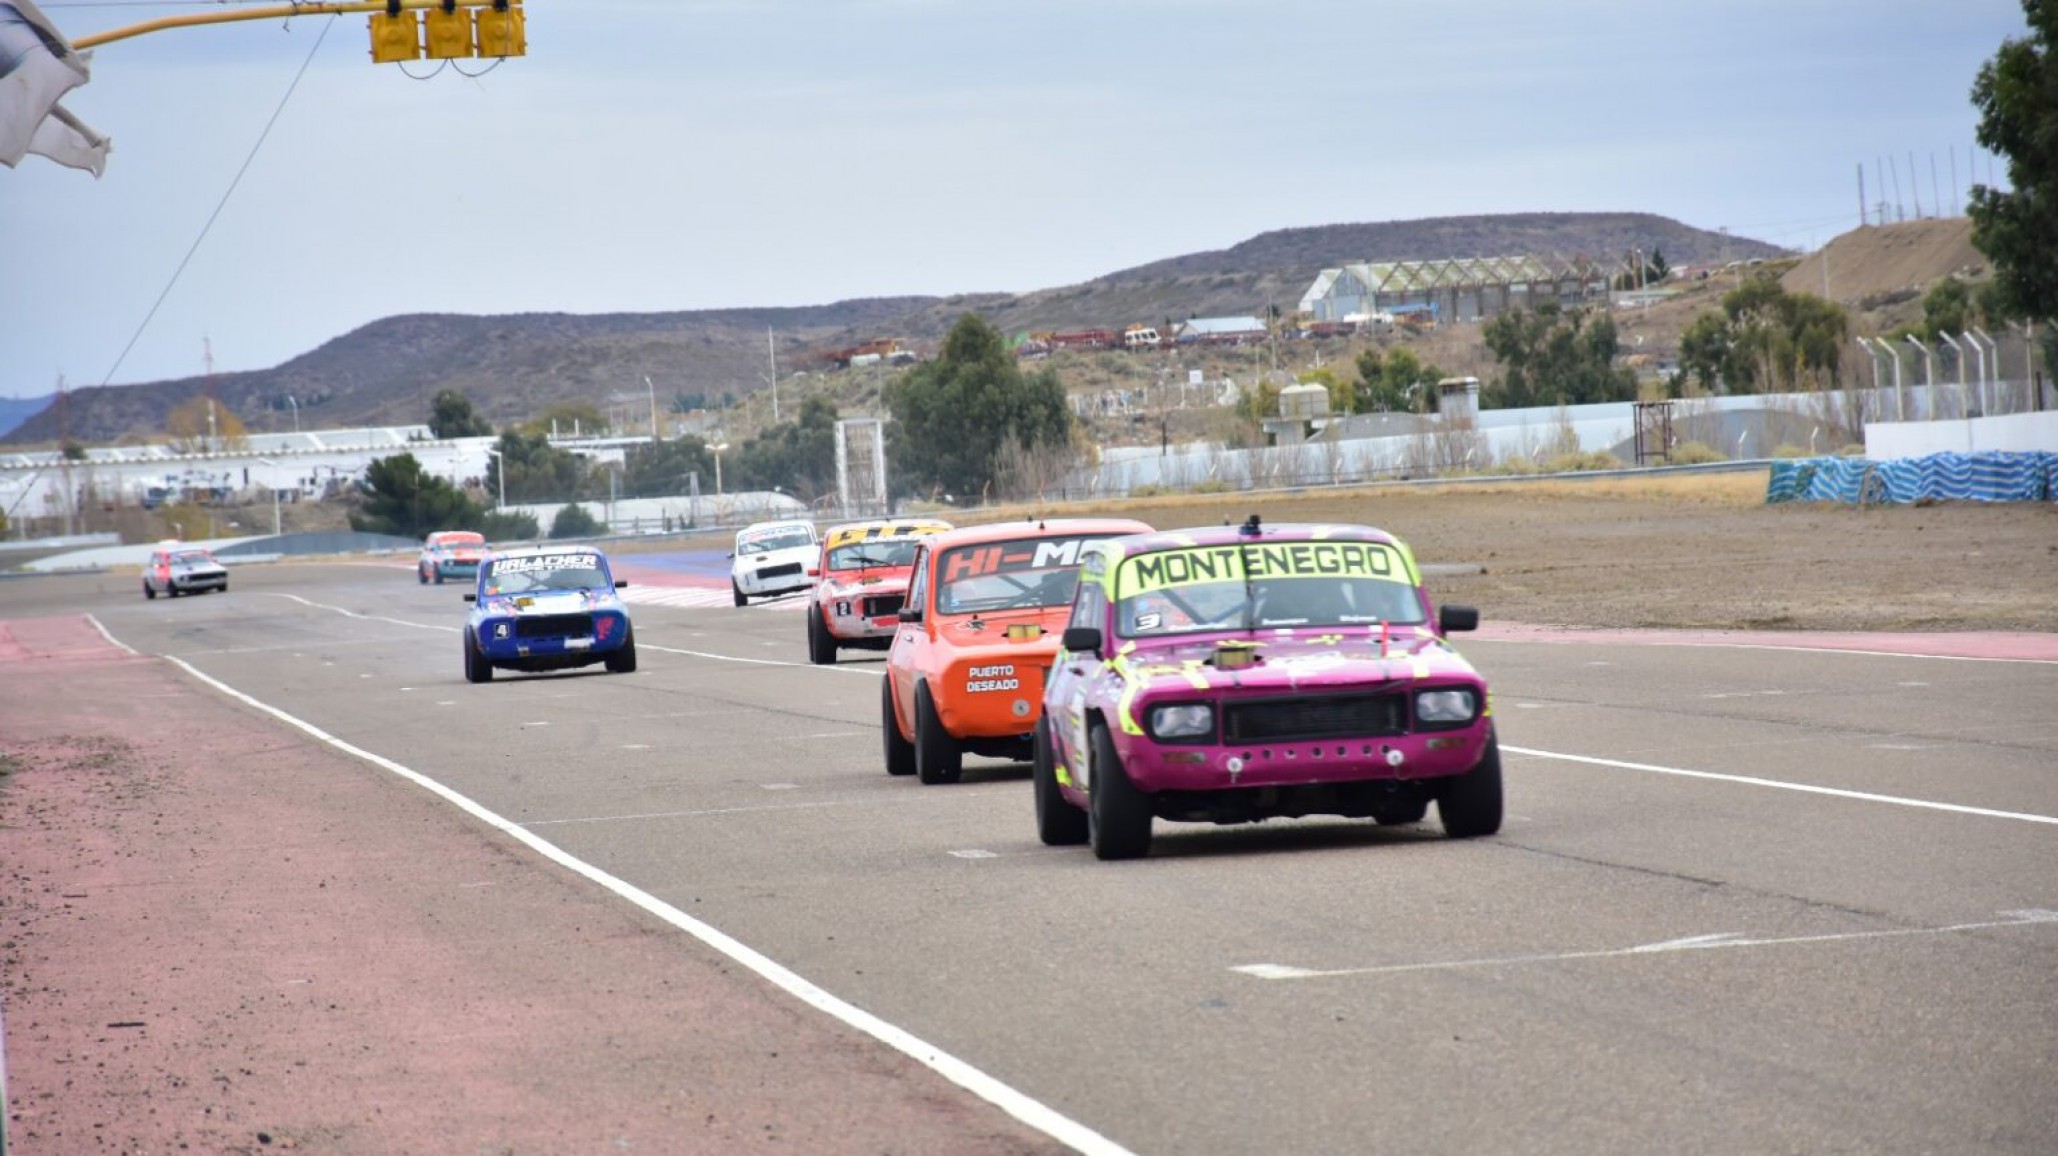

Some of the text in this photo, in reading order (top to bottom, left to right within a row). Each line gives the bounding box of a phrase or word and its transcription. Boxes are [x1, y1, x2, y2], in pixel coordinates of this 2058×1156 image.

[493, 555, 597, 573] URLACHER
[944, 540, 1085, 583] HI-M
[1135, 545, 1392, 589] MONTENEGRO
[1136, 613, 1161, 630] 3
[969, 665, 1014, 678] PUERTO
[967, 679, 1019, 692] DESEADO
